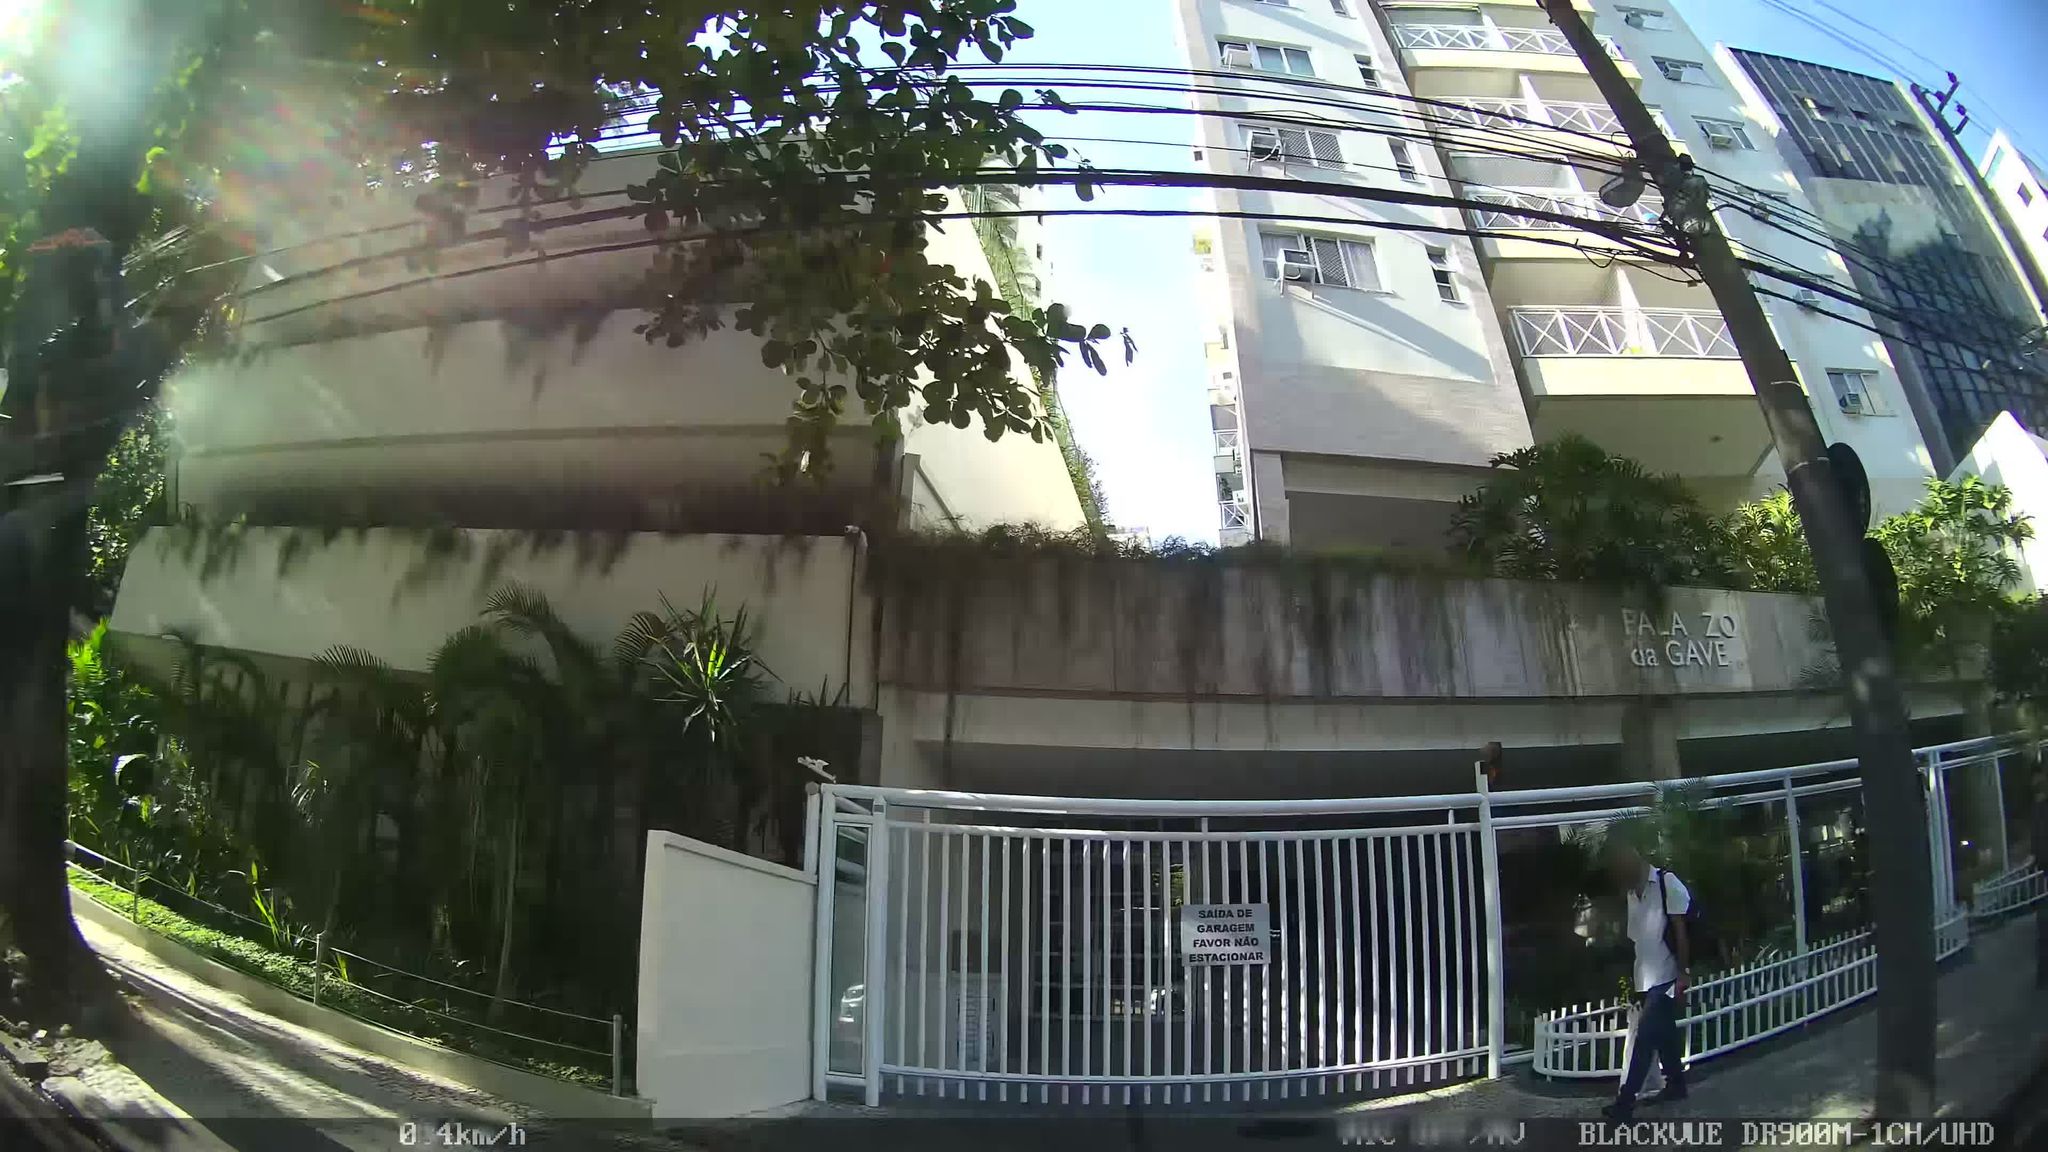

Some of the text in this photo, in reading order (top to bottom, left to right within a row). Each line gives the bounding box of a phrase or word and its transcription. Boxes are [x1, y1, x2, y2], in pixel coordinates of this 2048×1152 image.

[1198, 908, 1253, 919] SAÍDA DE
[1197, 923, 1255, 933] GARAGEM
[1193, 935, 1259, 948] FAVOR NÃO
[1189, 951, 1264, 963] ESTACIONAR
